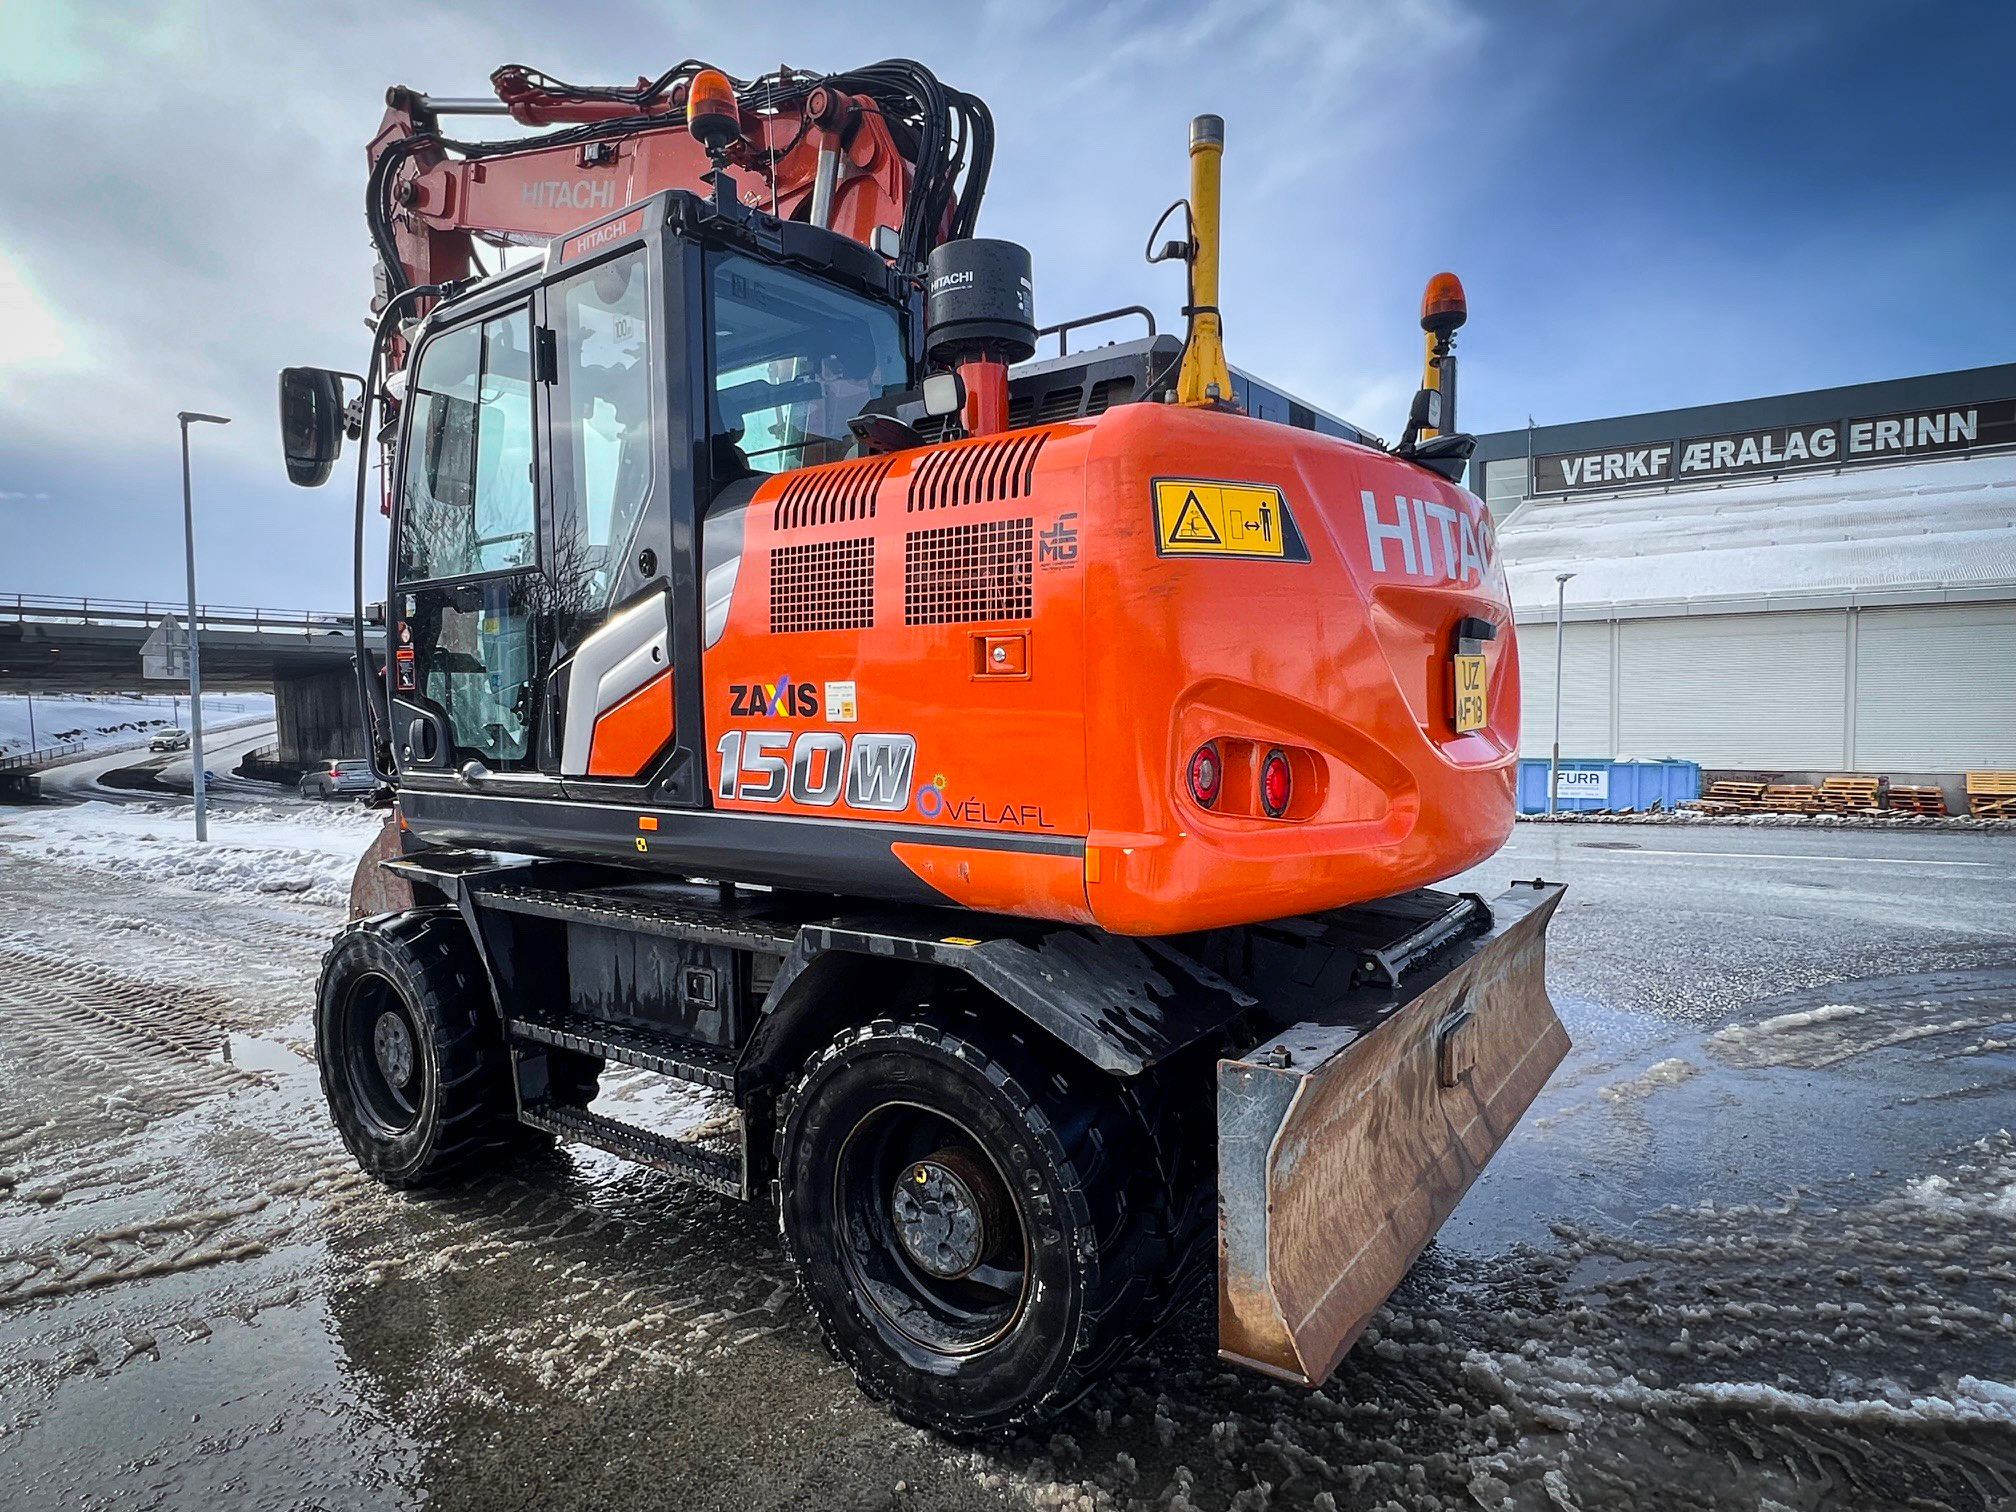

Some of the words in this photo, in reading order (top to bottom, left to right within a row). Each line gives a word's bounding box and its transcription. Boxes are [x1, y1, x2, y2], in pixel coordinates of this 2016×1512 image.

[520, 180, 616, 209] HITACHI
[576, 220, 627, 253] HITACHI
[930, 270, 974, 293] HITACHI
[1462, 660, 1480, 690] UZ
[729, 675, 819, 719] ZAXIS
[716, 730, 917, 812] 150W
[1557, 772, 1600, 784] FURA
[945, 796, 1055, 829] VÉLAFL
